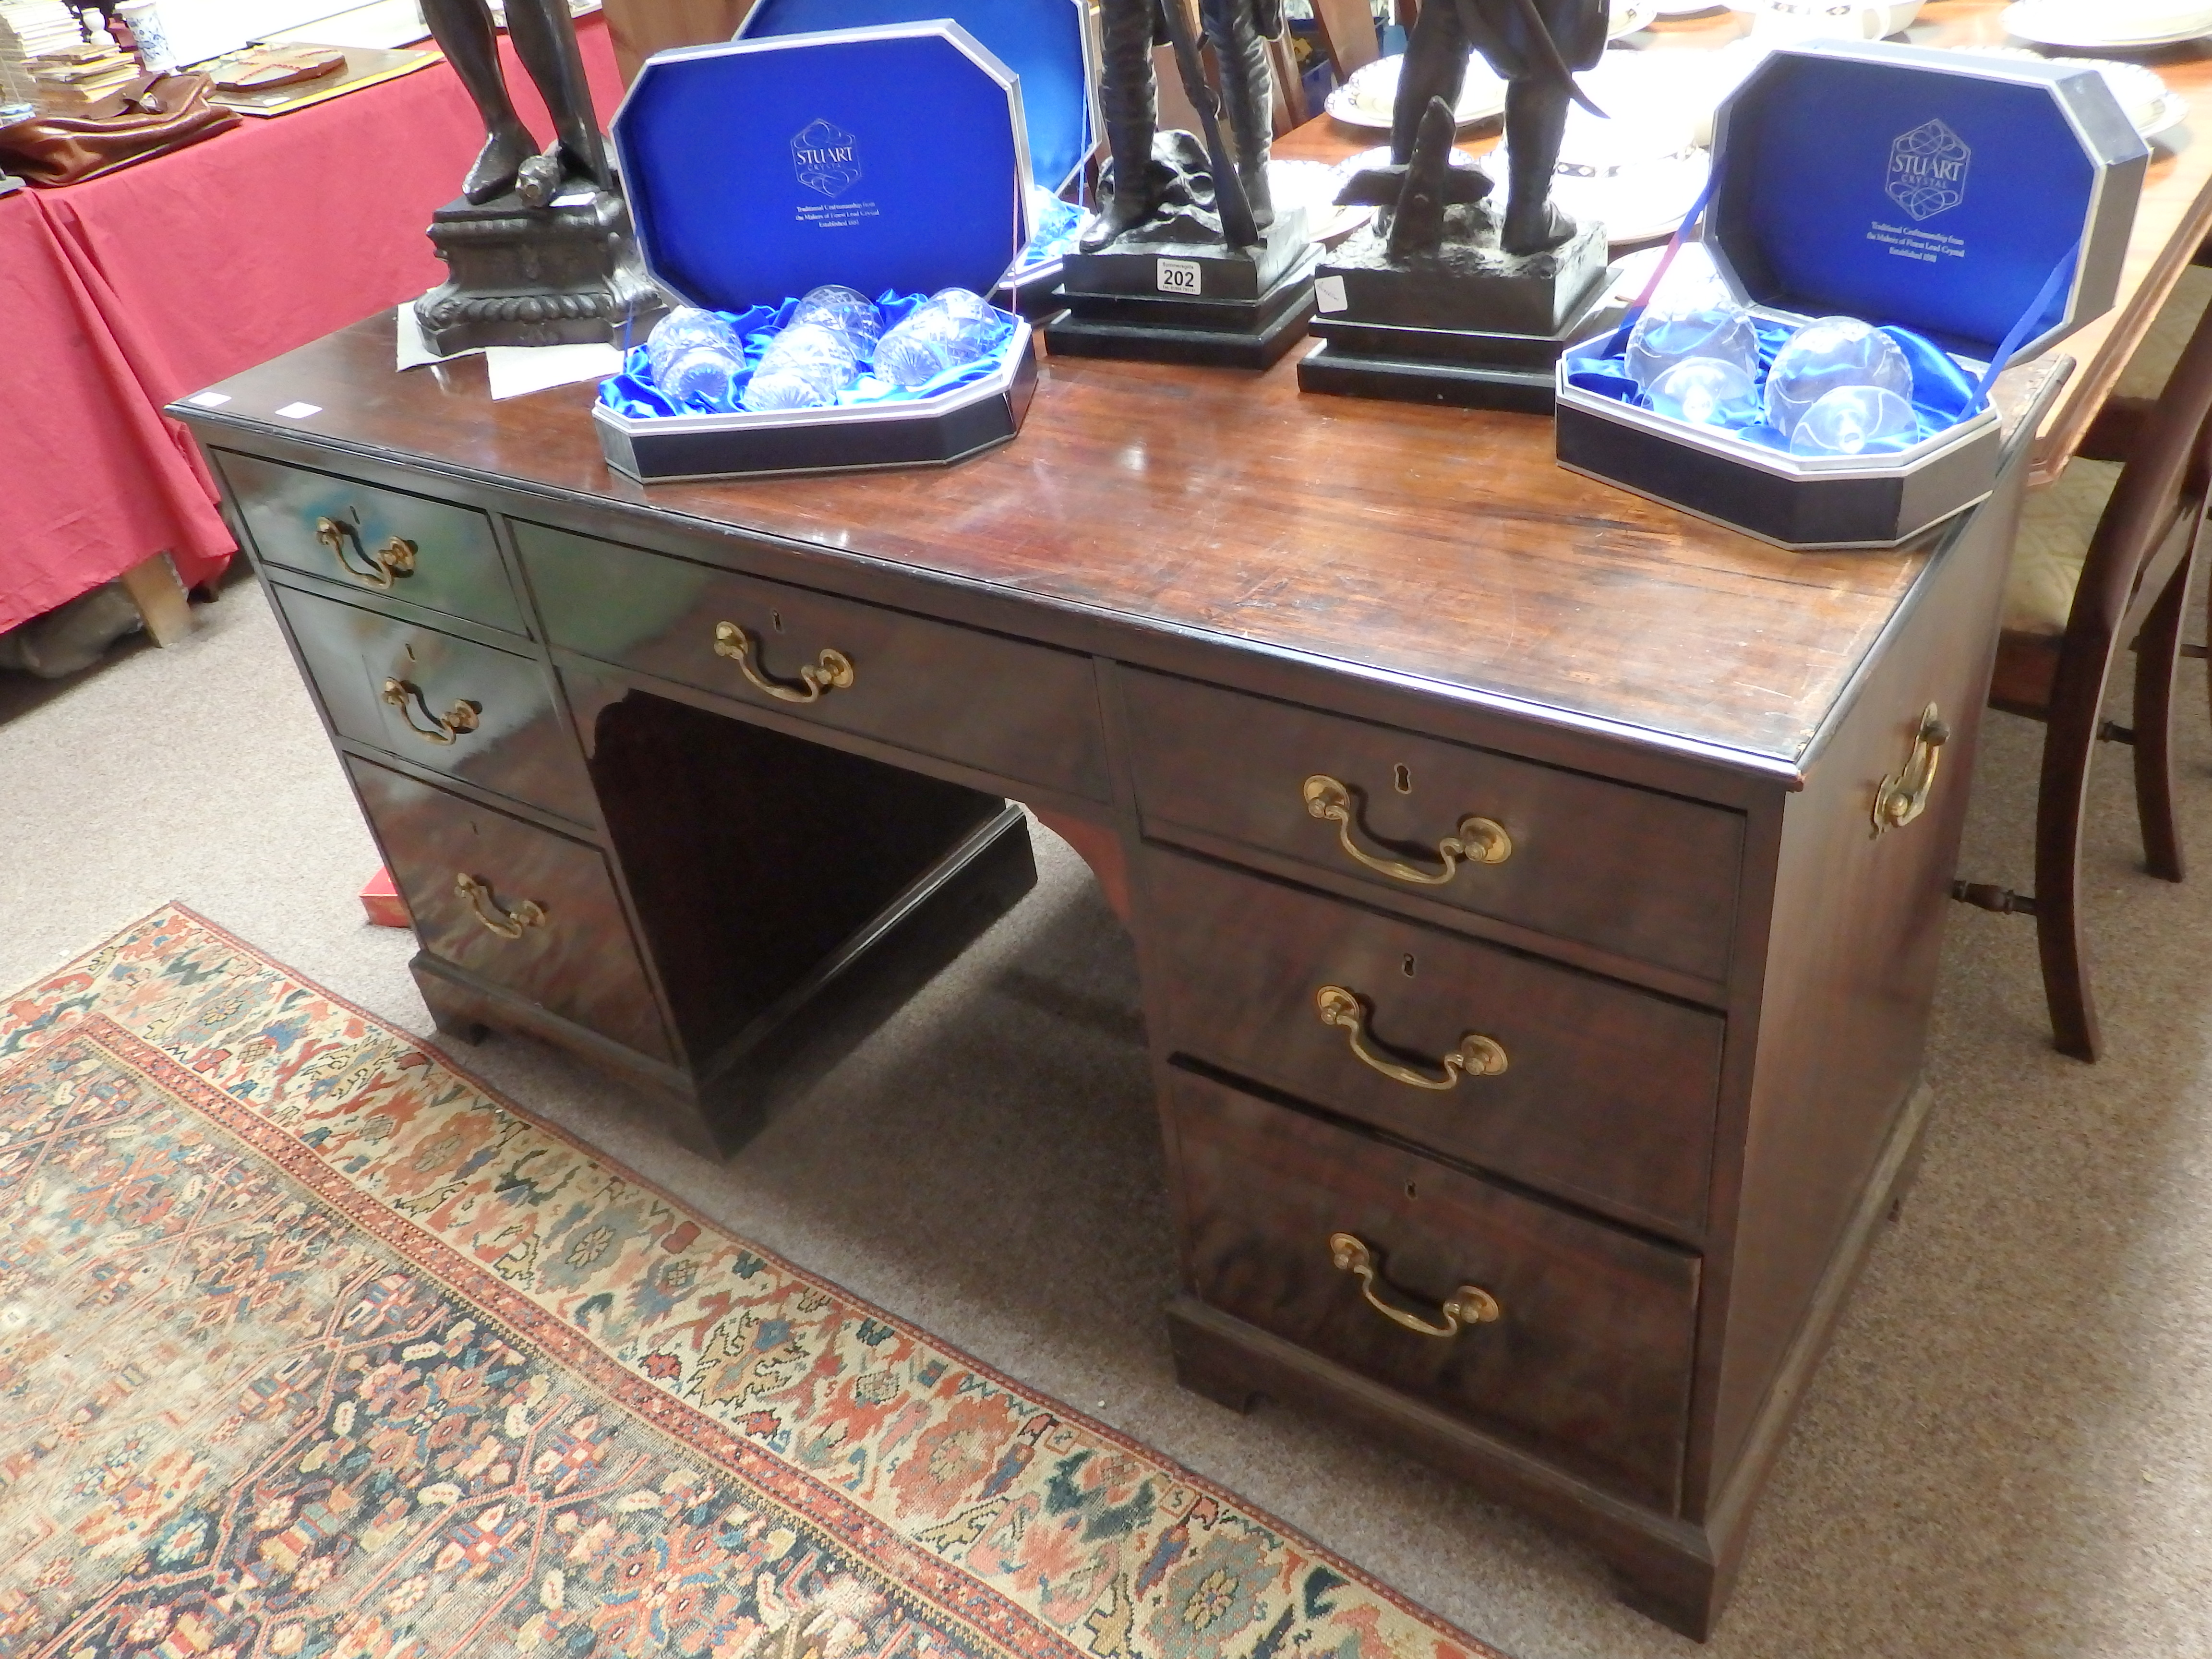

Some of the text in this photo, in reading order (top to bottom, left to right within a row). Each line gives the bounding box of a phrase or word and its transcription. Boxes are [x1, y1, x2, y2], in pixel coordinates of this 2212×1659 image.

[797, 147, 853, 165] STUART
[1892, 154, 1964, 181] STUART
[1900, 173, 1947, 189] CRYSTAL
[1164, 270, 1193, 287] 202
